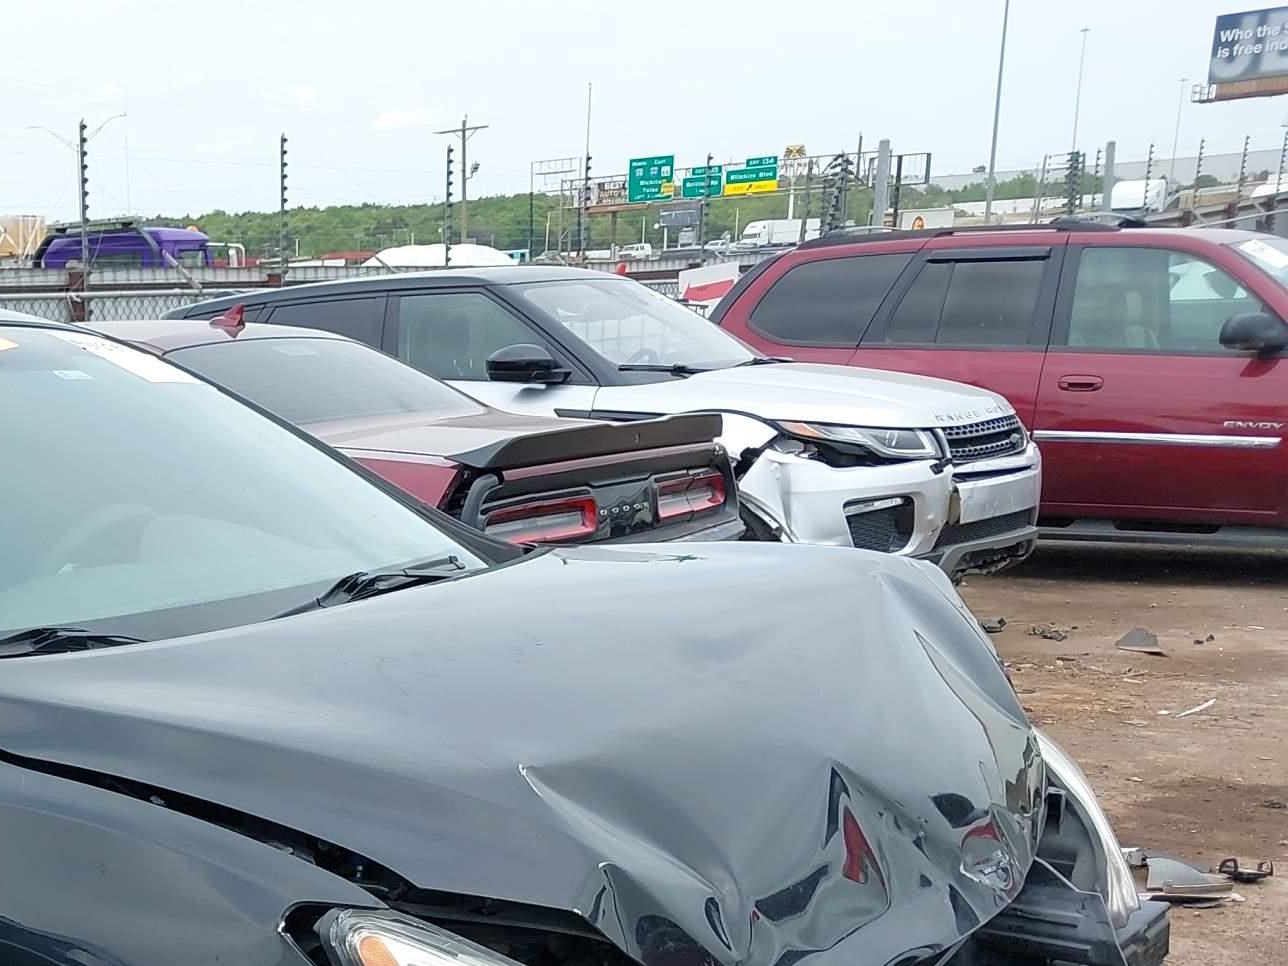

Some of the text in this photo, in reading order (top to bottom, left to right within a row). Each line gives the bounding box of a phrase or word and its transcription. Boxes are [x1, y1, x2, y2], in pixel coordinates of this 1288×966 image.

[1220, 28, 1253, 42] Who
[1256, 25, 1280, 38] the
[1216, 46, 1230, 58] is
[1232, 43, 1262, 56] free
[604, 182, 624, 190] BEST
[934, 410, 982, 423] RANGE
[1223, 420, 1285, 429] ENVOY
